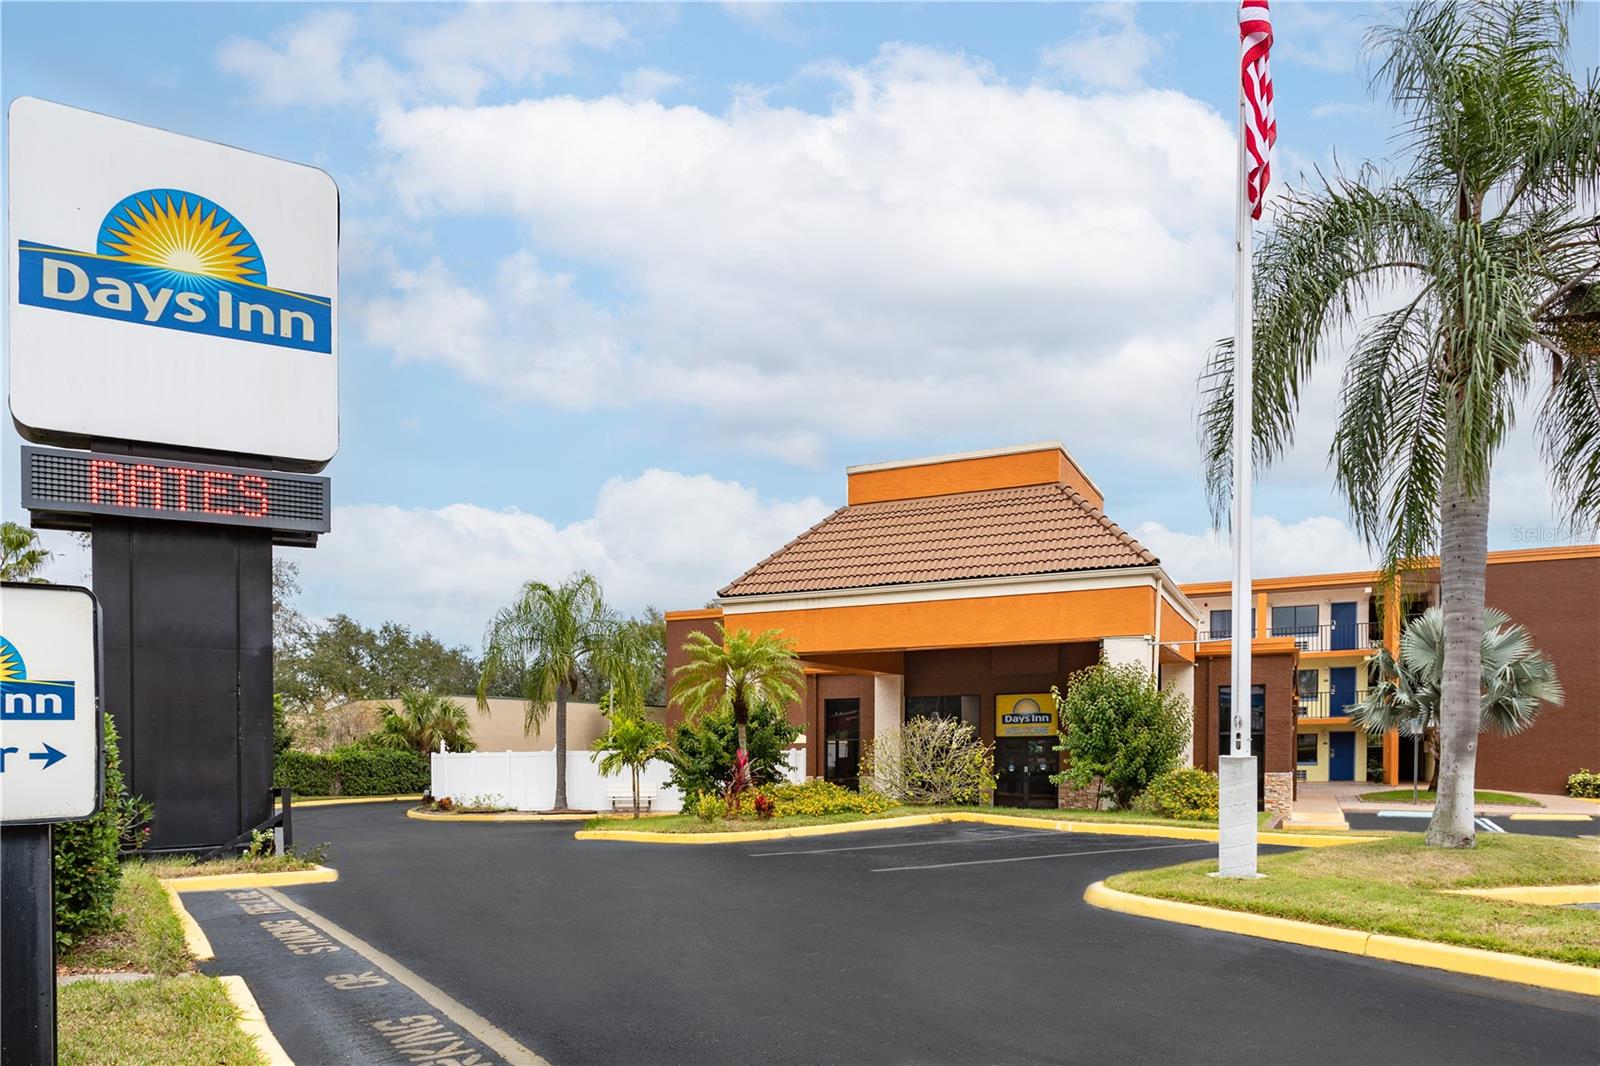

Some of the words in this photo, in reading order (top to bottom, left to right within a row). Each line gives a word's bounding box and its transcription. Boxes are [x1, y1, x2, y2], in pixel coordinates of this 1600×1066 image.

[42, 257, 207, 323] Days
[219, 291, 315, 342] Inn
[92, 460, 268, 517] RATES
[5, 692, 63, 714] nn
[1005, 714, 1030, 724] Days
[1031, 713, 1050, 722] Inn
[325, 971, 389, 990] OR
